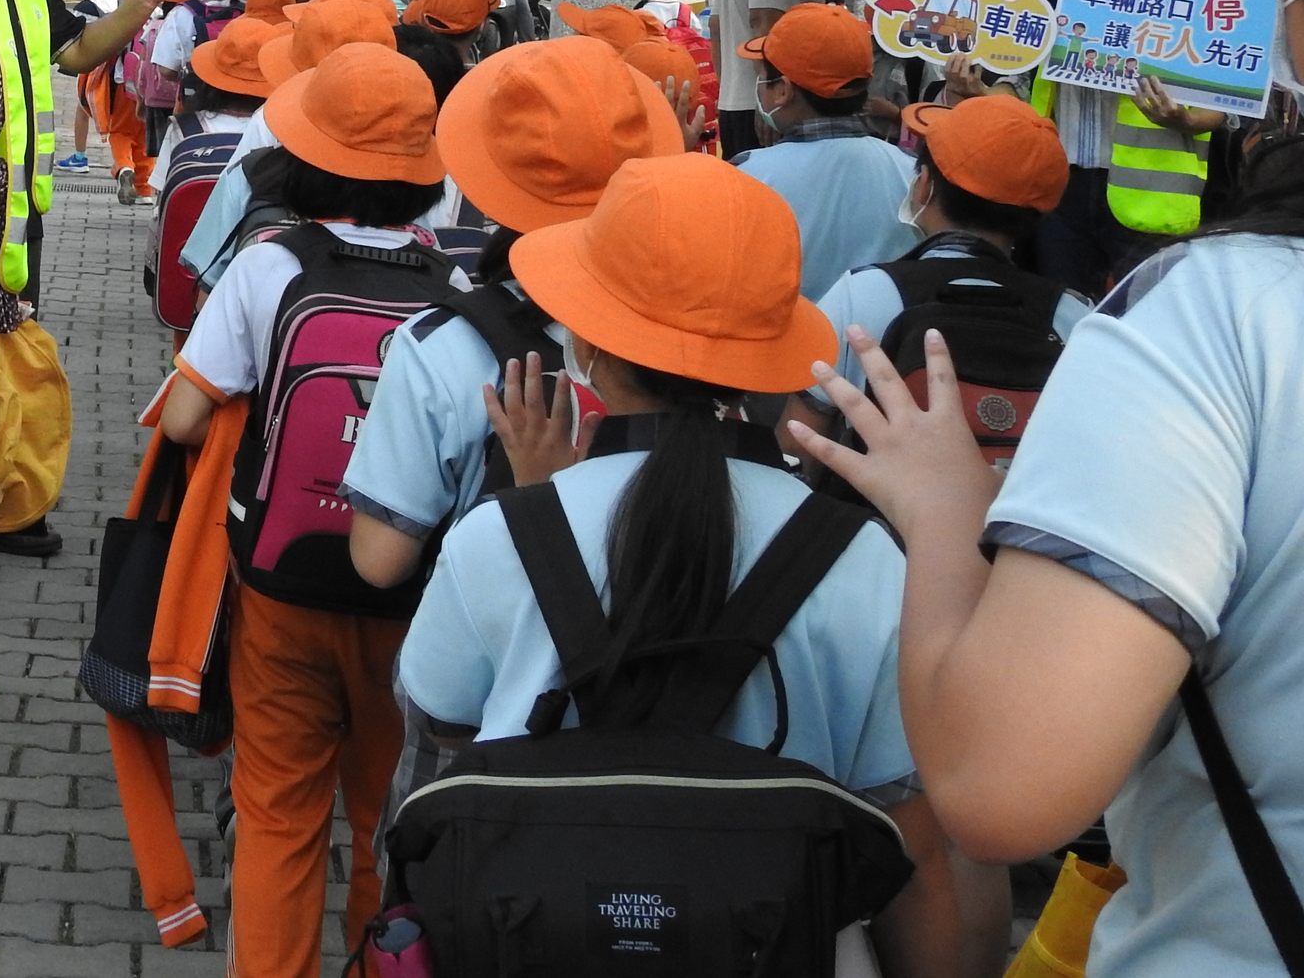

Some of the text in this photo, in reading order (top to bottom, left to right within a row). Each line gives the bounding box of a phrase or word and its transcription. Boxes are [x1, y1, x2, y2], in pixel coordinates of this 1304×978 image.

[980, 5, 1049, 49] 車輛
[611, 893, 662, 905] LIVING
[598, 903, 676, 918] TRAVELING
[613, 916, 661, 930] SHARE
